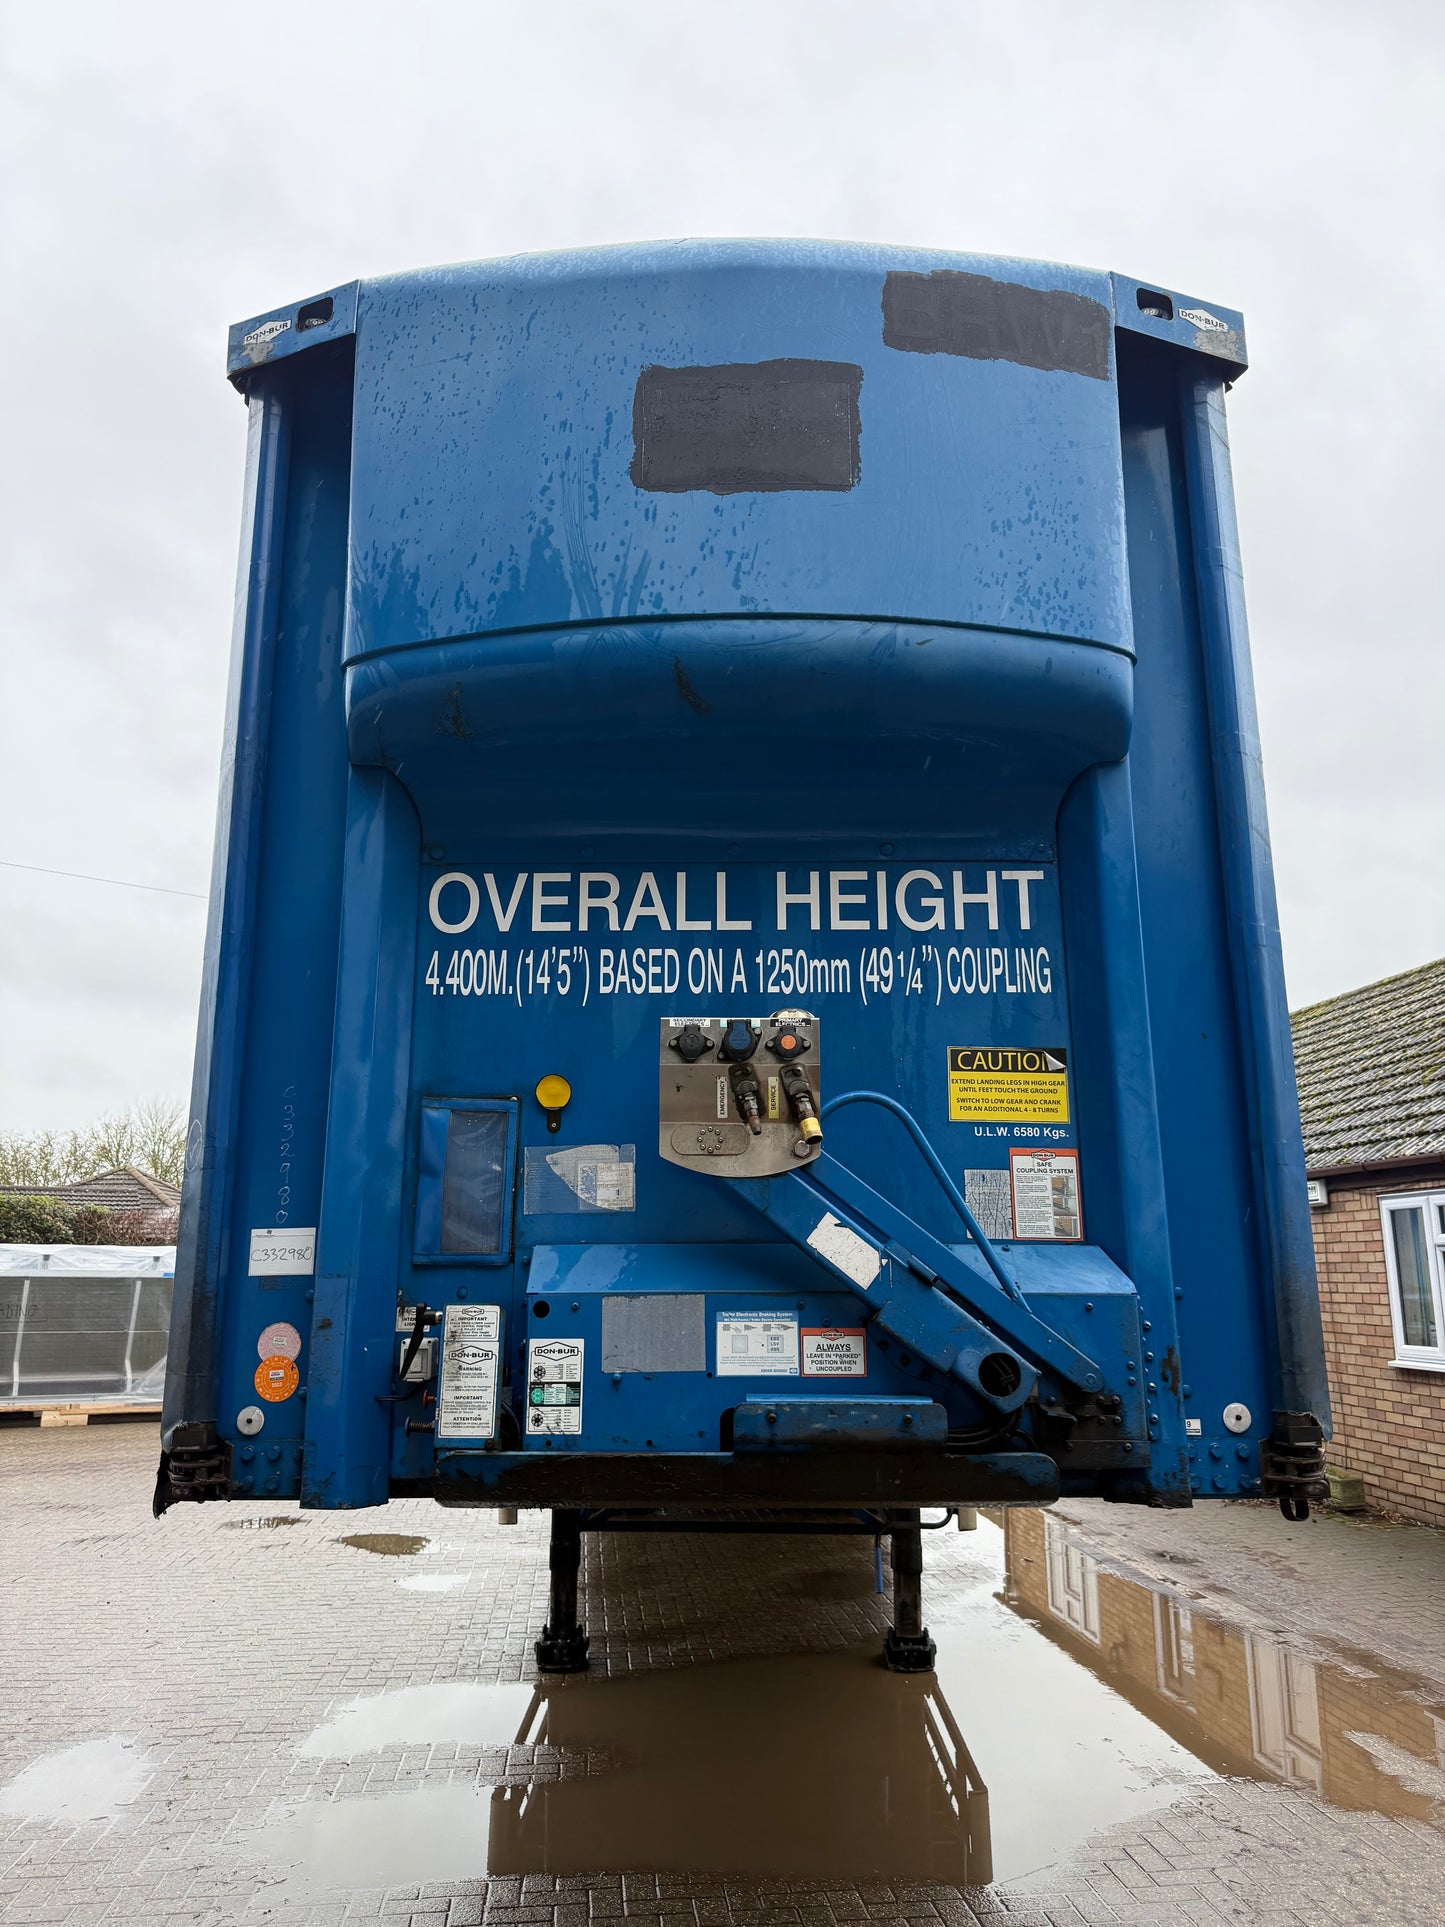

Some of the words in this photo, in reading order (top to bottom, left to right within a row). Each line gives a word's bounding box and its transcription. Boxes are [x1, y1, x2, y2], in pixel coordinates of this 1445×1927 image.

[1181, 310, 1225, 329] DON-BUR
[246, 322, 288, 342] DON-BUR
[428, 871, 751, 933] OVERALL
[776, 869, 1044, 931] HEIGHT
[599, 948, 680, 995] BASED
[687, 947, 723, 994] ON
[730, 948, 748, 994] A
[756, 949, 851, 994] 1250mm
[946, 946, 1052, 994] COUPLING
[974, 1126, 1011, 1137] U.L.W.
[1013, 1127, 1040, 1137] 6580
[1043, 1127, 1070, 1139] Kgs.
[250, 1246, 313, 1262] C332980
[815, 1343, 852, 1351] ALWAYS
